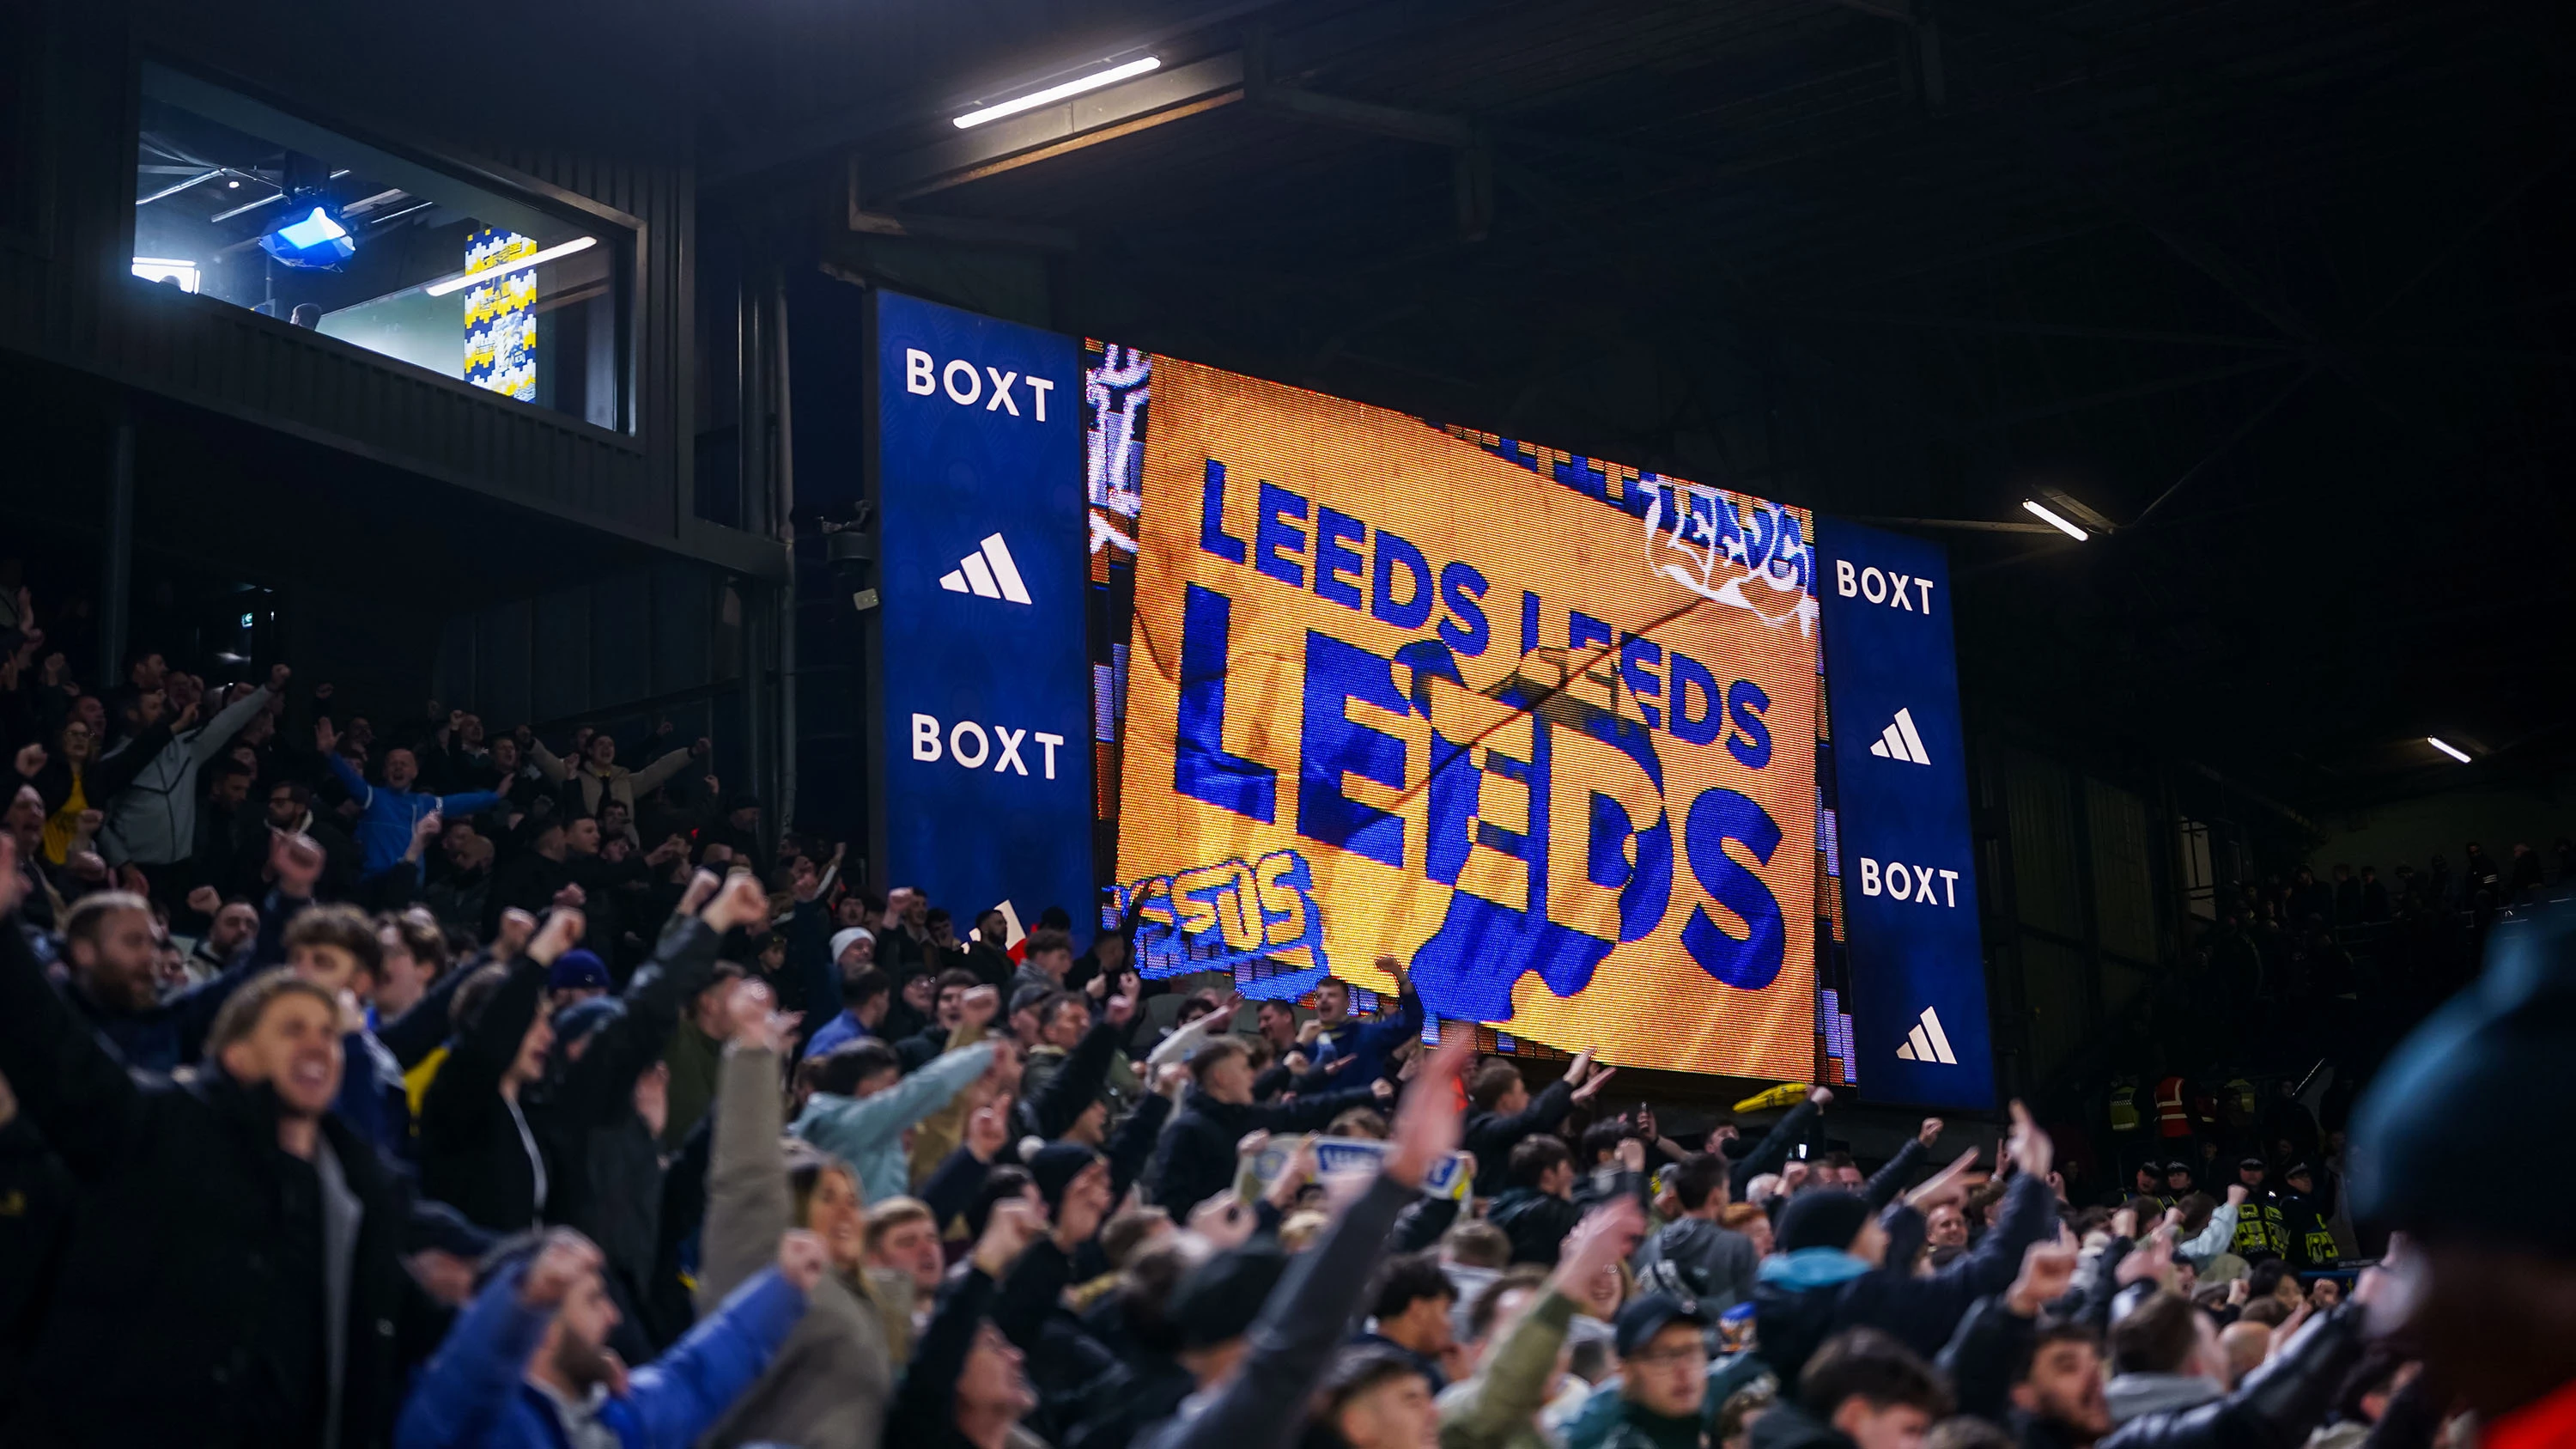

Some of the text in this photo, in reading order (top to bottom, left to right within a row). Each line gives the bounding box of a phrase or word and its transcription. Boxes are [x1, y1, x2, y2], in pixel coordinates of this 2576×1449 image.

[906, 348, 1054, 422] BOXT
[1200, 458, 1490, 657] LEEDS
[1521, 590, 1772, 770] LEEDS
[1836, 559, 1934, 615] BOXT
[912, 713, 1064, 780] BOXT
[1174, 582, 1786, 990] LEEDS
[1860, 857, 1959, 908] BOXT
